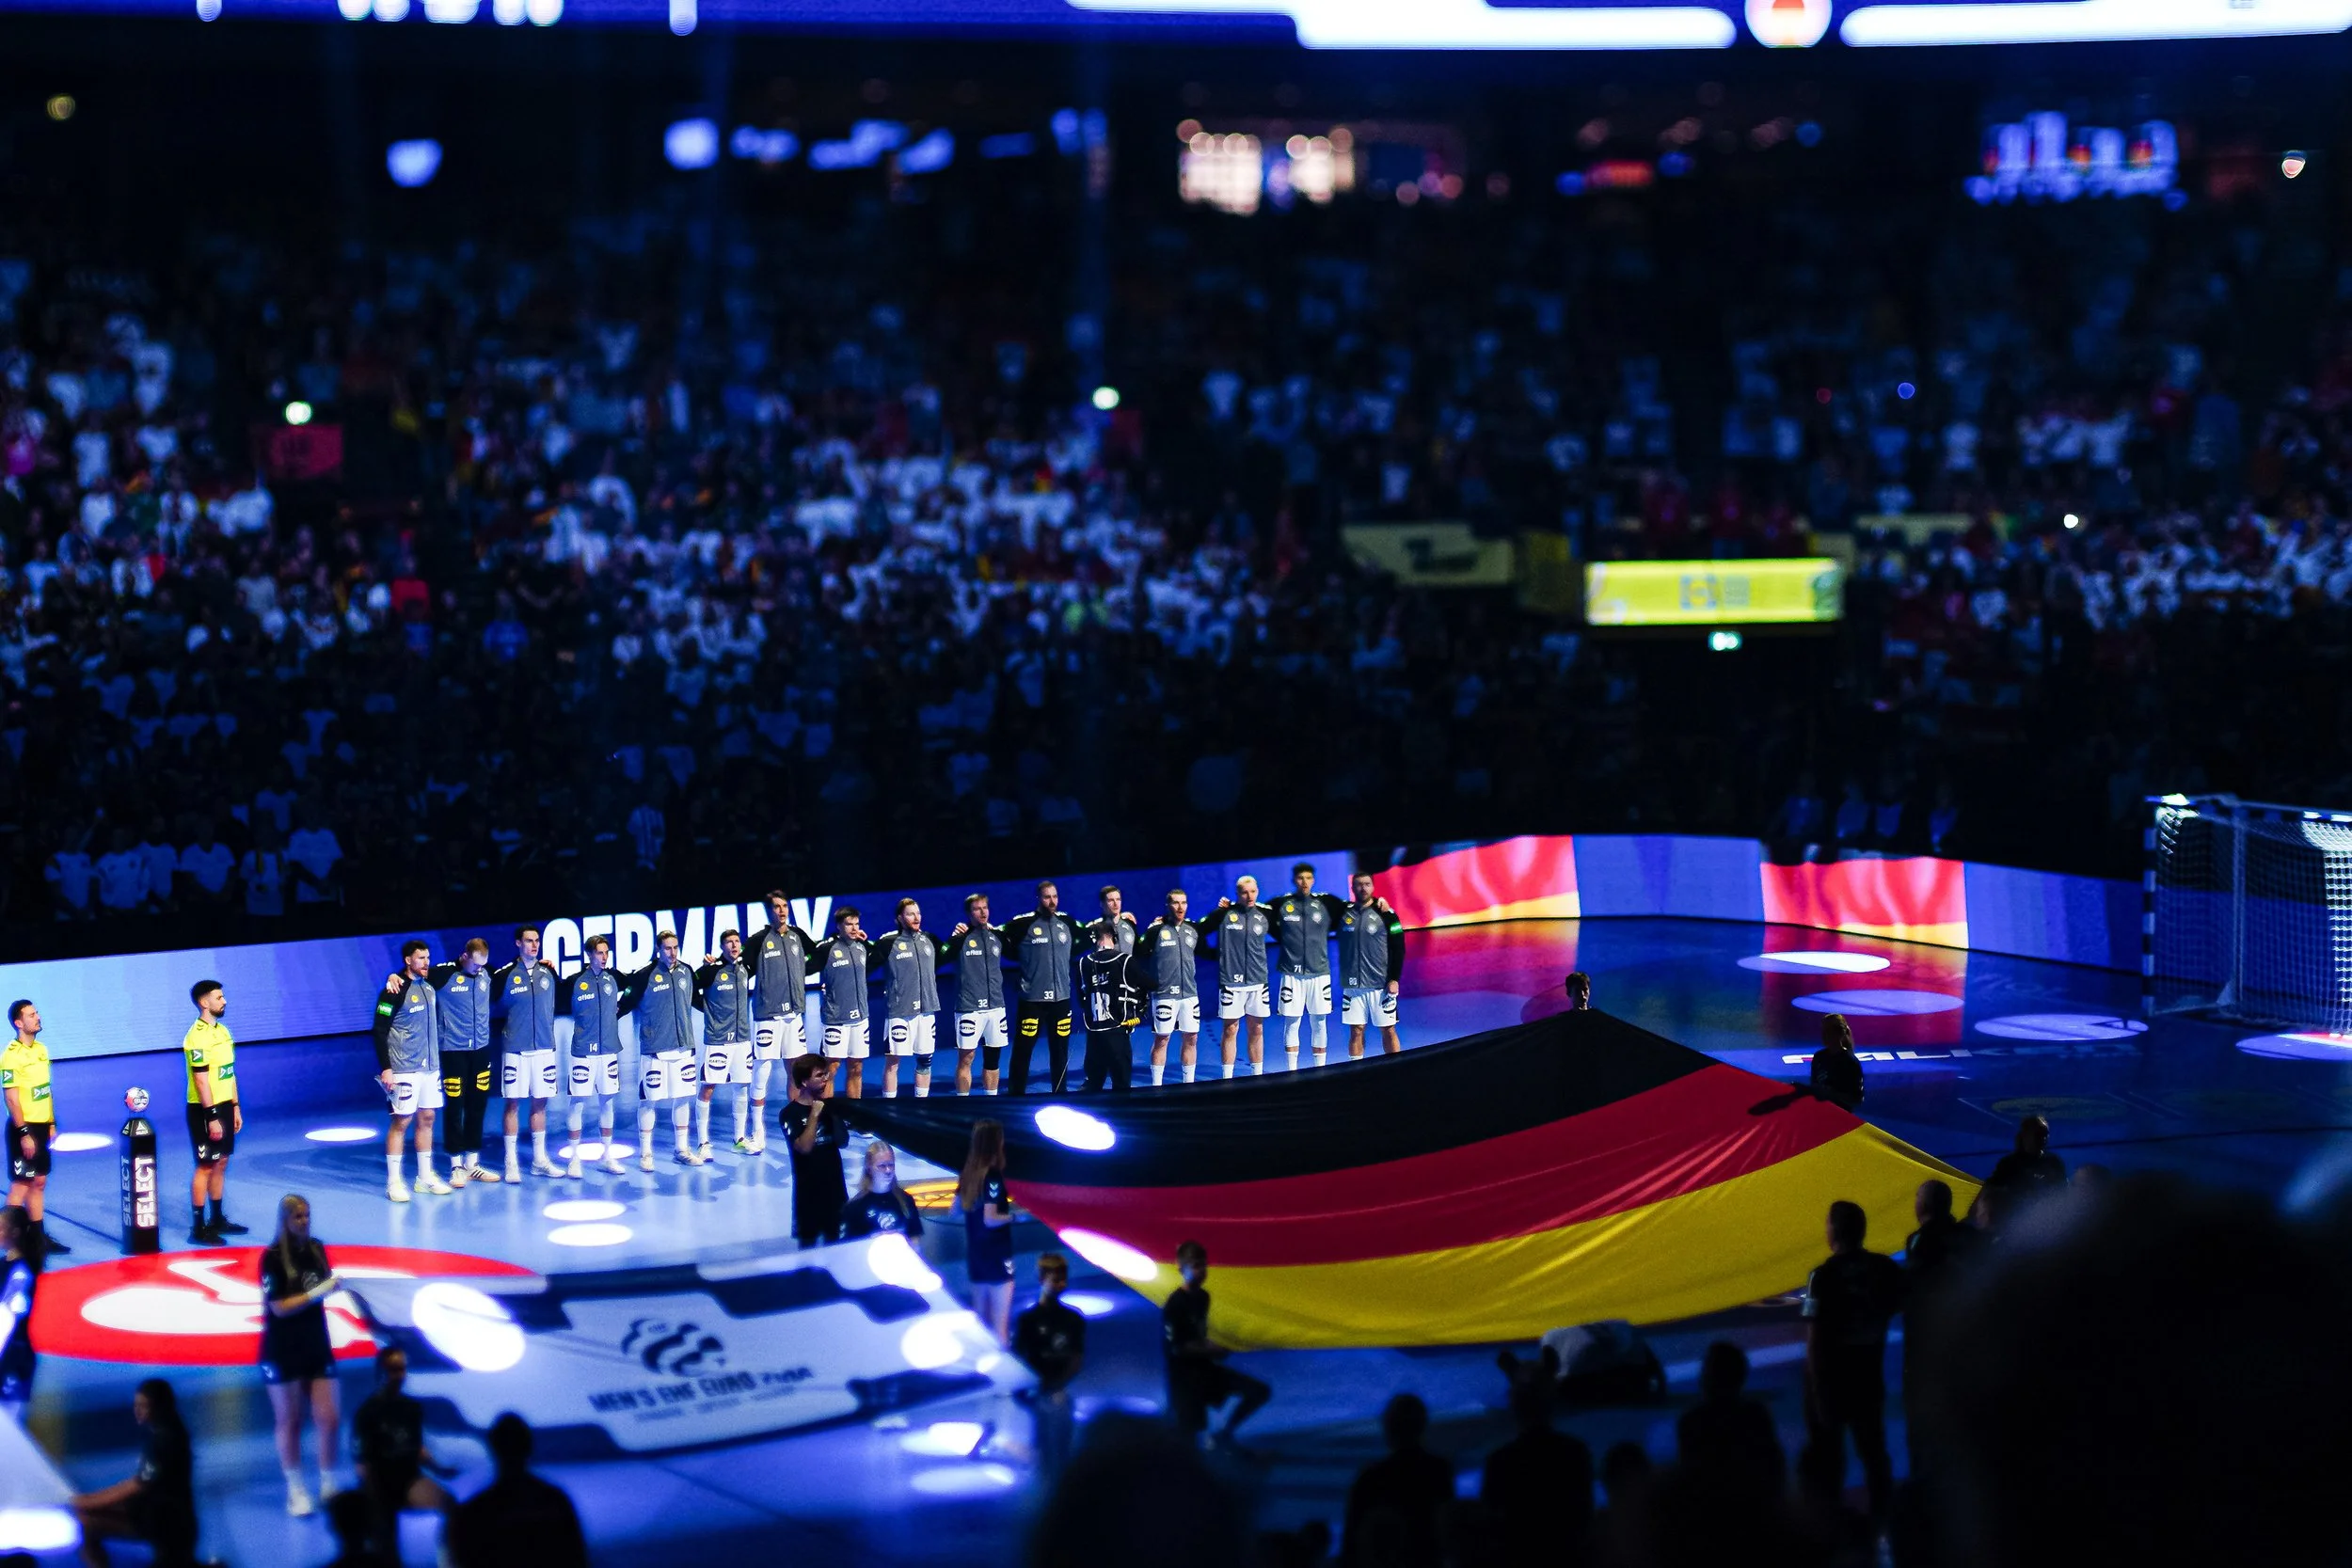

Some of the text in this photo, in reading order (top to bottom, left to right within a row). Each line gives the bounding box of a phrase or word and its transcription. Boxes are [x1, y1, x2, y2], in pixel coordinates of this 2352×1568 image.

[764, 950, 781, 958] atlas
[896, 951, 914, 959] atlas
[832, 959, 850, 968] atlas
[1294, 964, 1302, 974] 71
[510, 986, 528, 995] atlas
[653, 983, 670, 992] atlas
[577, 992, 595, 1002] atlas
[1043, 990, 1054, 1000] 33
[782, 1002, 790, 1012] 18
[977, 999, 988, 1008] 32
[409, 1005, 425, 1014] atlas
[850, 1008, 860, 1020] 23
[727, 1032, 735, 1040] 17
[590, 1043, 597, 1053] 14
[421, 1058, 427, 1068] 4
[121, 1155, 133, 1227] SELECT
[135, 1156, 156, 1227] SELECT
